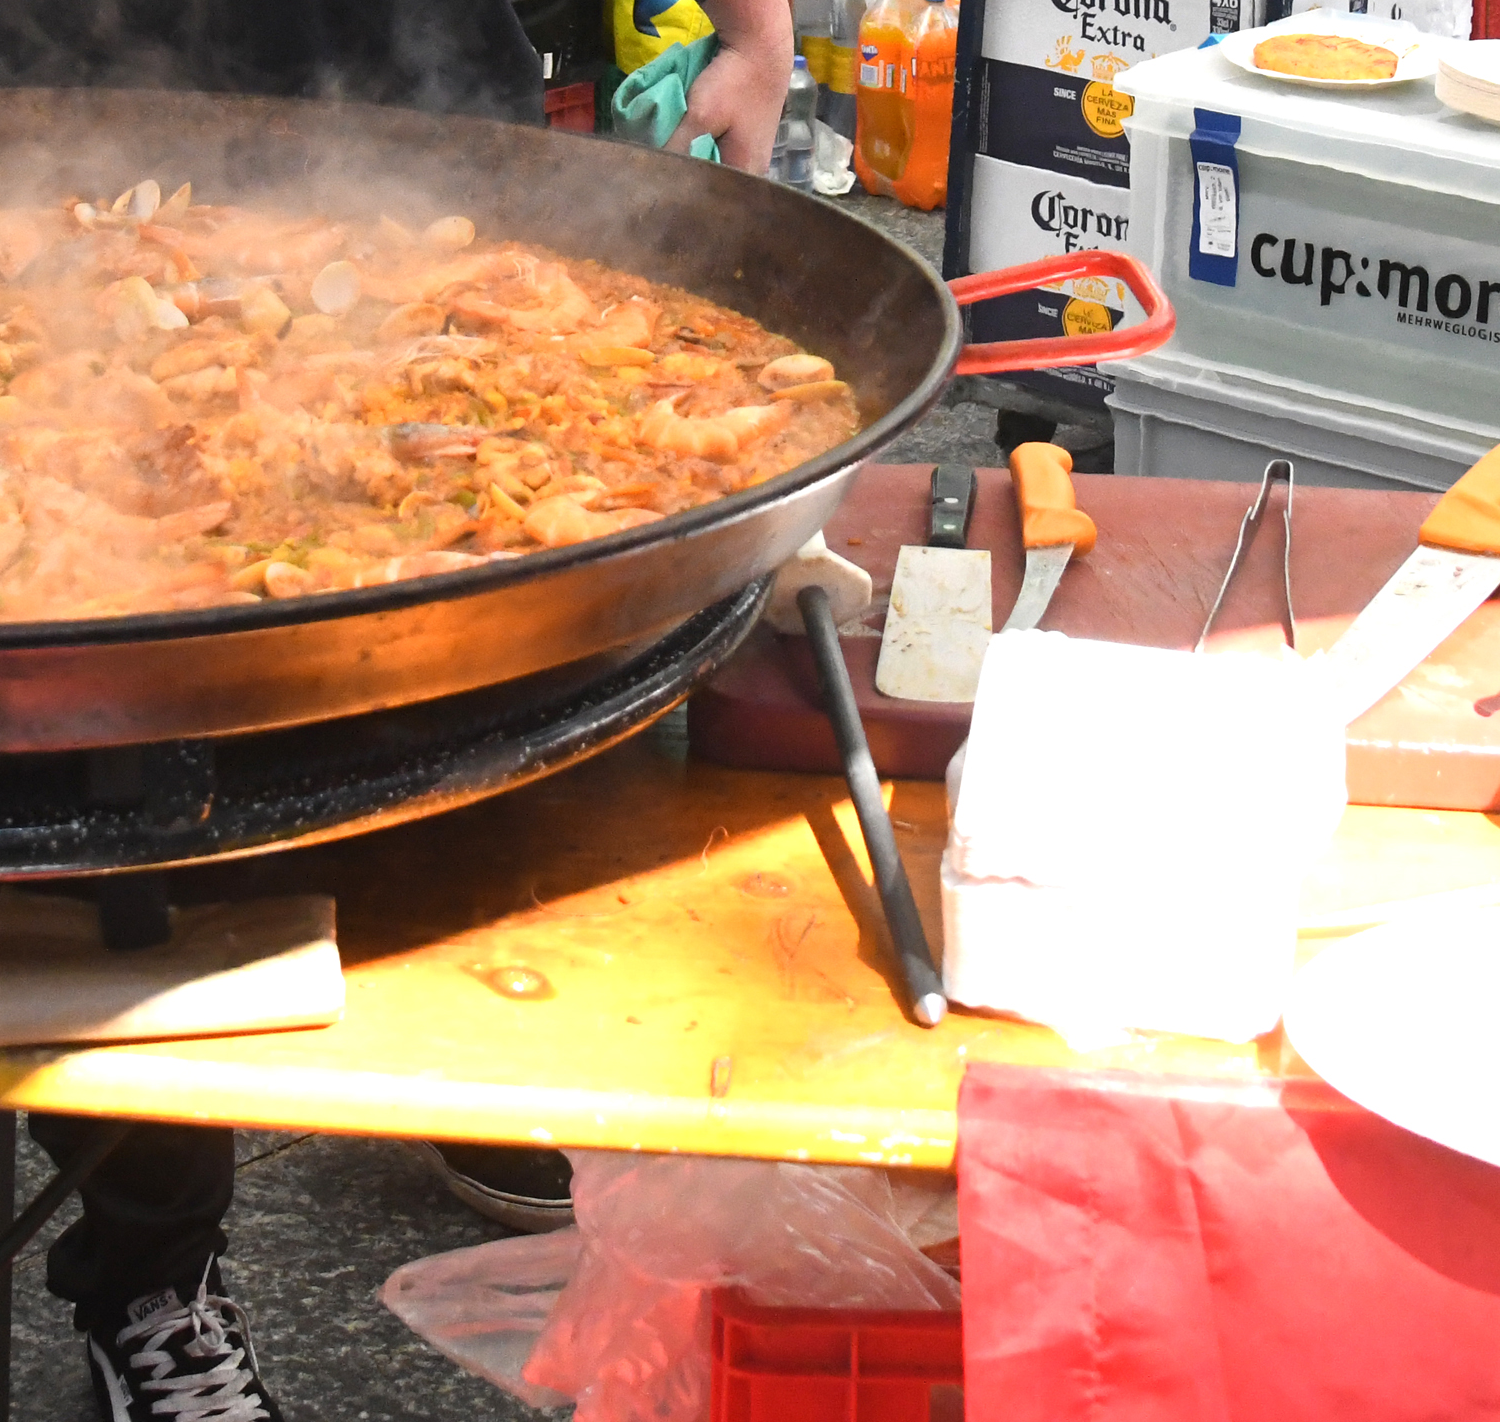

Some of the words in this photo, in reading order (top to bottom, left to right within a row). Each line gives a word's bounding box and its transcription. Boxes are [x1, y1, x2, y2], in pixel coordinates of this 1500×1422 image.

[1080, 11, 1146, 53] Extra
[1053, 86, 1077, 101] SINCE
[1101, 88, 1114, 98] LA
[1086, 94, 1130, 112] CERVEZA
[1096, 106, 1117, 119] MAS
[1095, 115, 1117, 127] FINA
